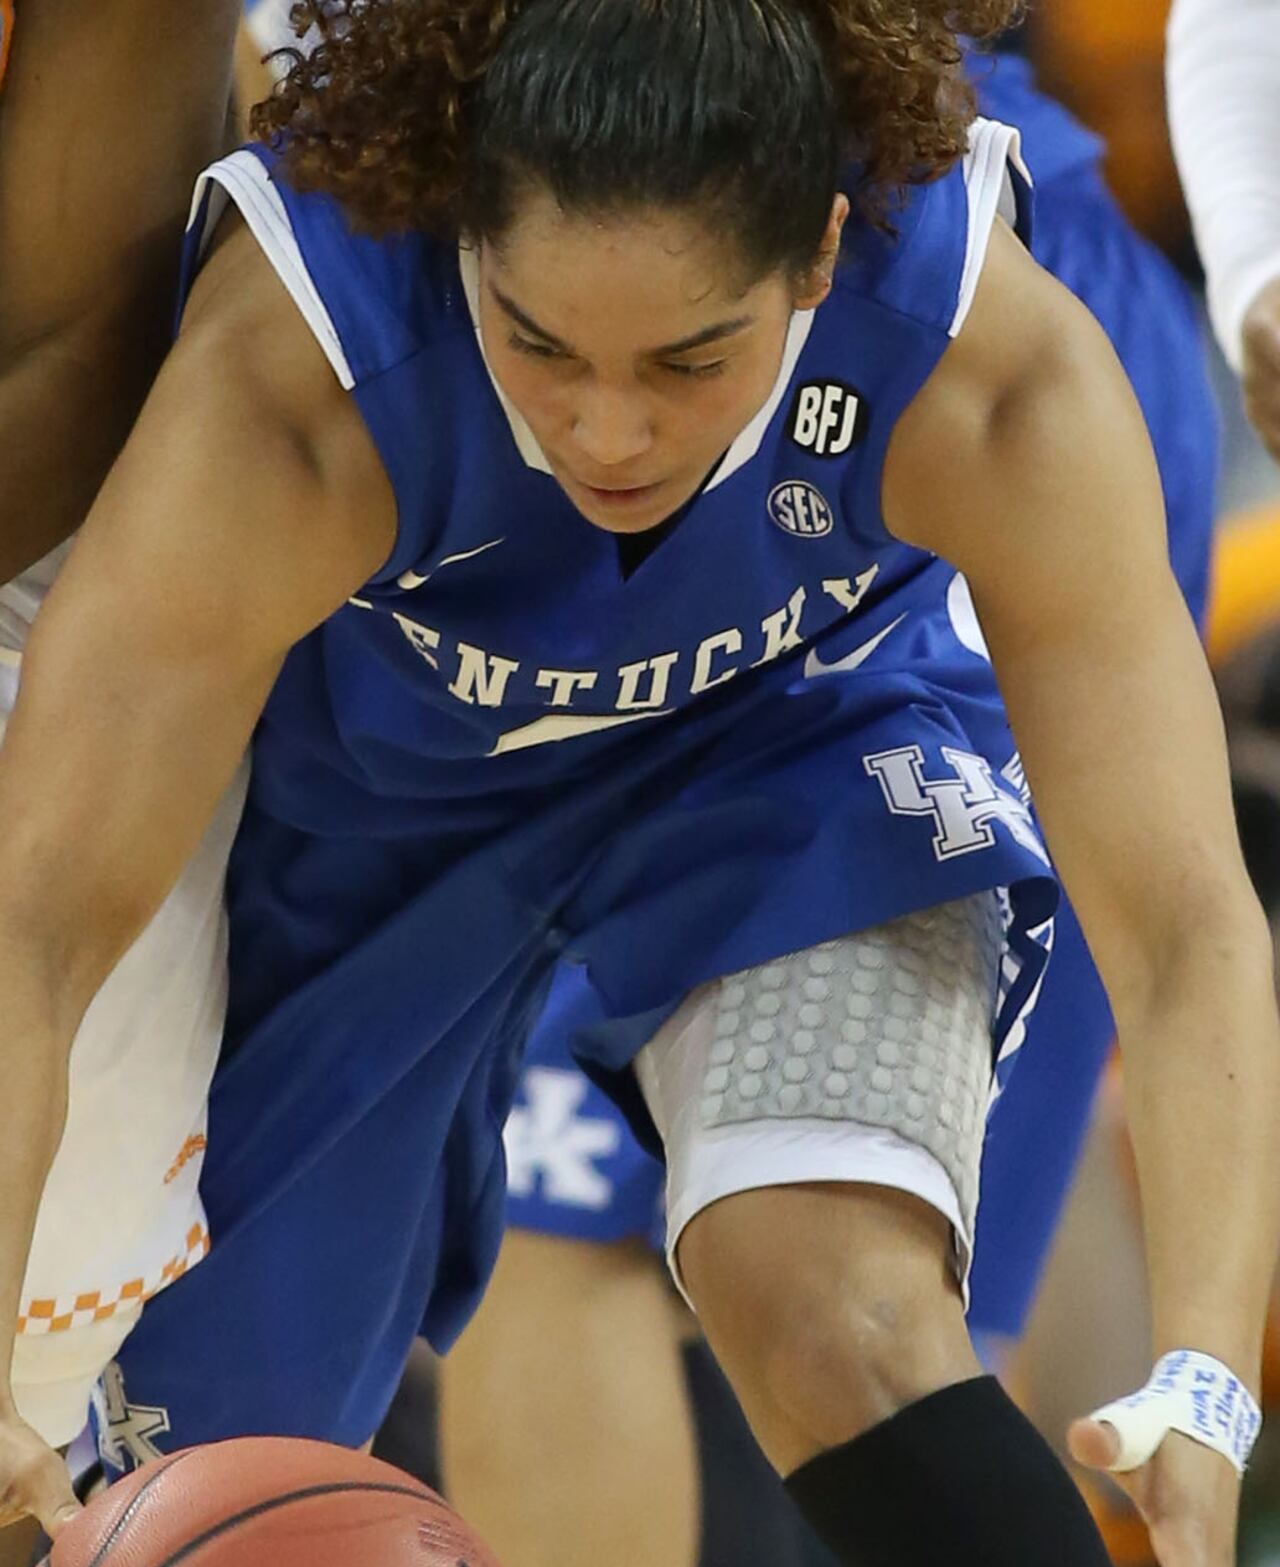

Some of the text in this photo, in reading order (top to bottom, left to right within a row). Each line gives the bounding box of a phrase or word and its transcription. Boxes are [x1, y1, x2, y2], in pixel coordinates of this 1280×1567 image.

[793, 384, 858, 454] BFJ
[773, 486, 830, 534] SEC
[348, 562, 880, 711] ENTUCKY
